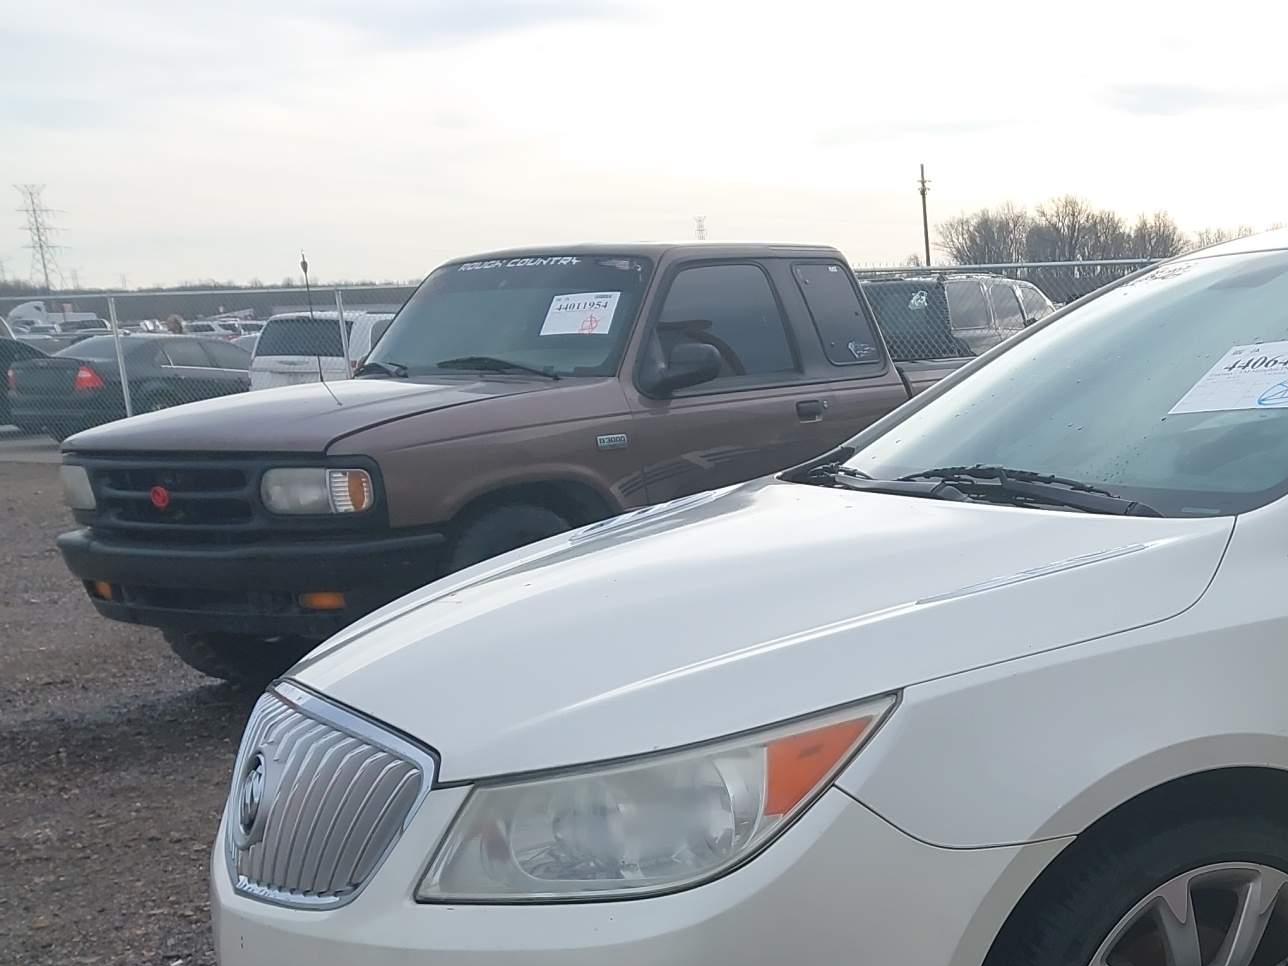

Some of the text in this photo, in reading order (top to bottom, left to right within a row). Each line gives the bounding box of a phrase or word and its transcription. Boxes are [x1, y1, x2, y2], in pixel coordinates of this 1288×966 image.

[458, 257, 581, 271] ROUGH COUNTRY
[556, 301, 608, 311] 44011954
